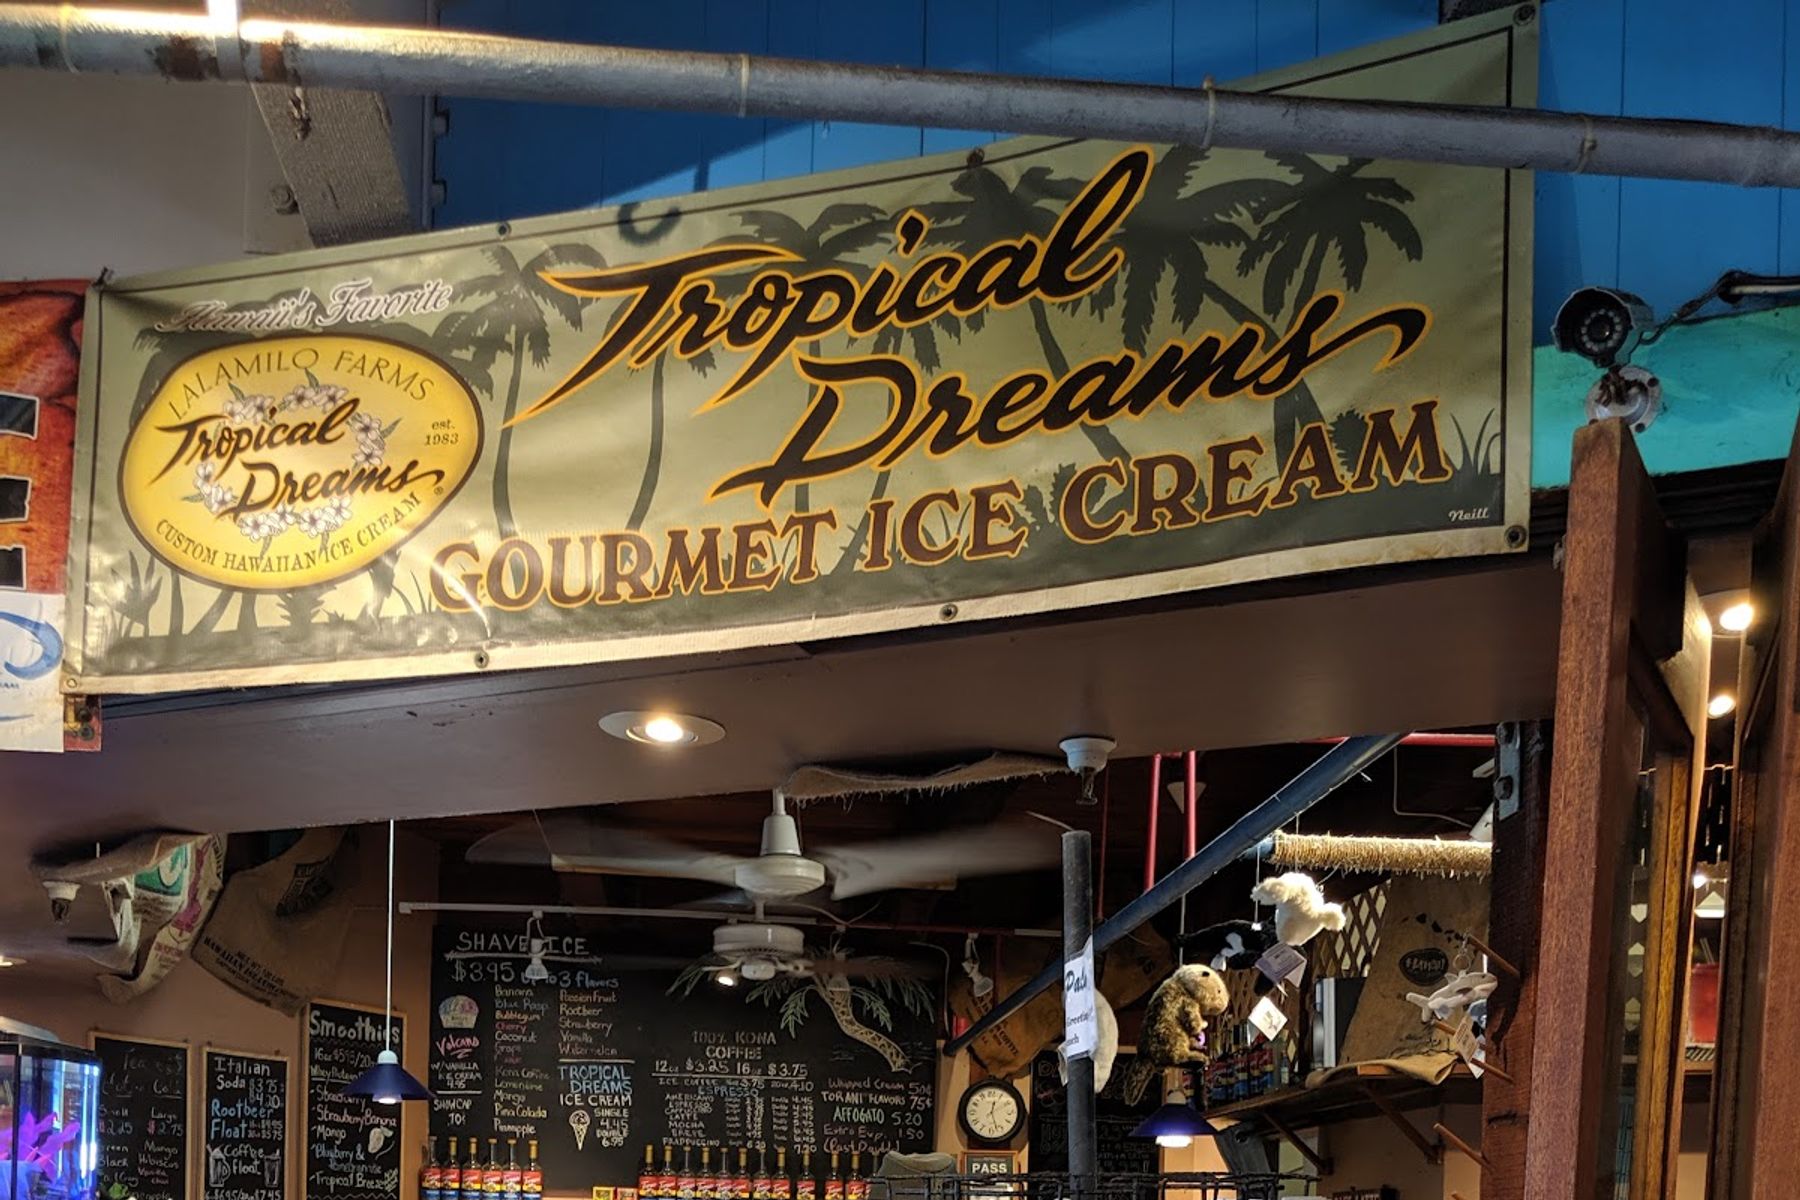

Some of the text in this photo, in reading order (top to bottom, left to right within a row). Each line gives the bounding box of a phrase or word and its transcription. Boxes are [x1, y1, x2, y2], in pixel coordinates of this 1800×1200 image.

[498, 143, 1155, 431] Tropical
[315, 277, 453, 326] Favorite
[167, 347, 434, 420] LALAMILO FARMS
[703, 290, 1432, 513] Dreams
[148, 398, 361, 485] Tropical
[424, 432, 460, 446] 1983
[215, 459, 445, 523] Dreams
[428, 400, 1451, 615] GOURMET ICE CREAM
[155, 492, 423, 574] CUSTOM HAWAIIAN ICE CREAM
[456, 931, 590, 955] SHAVE ICE
[452, 959, 515, 982] $3.95
[735, 1031, 777, 1045] KONA
[705, 1046, 762, 1060] COFFEE
[216, 1074, 246, 1090] Soda
[557, 1065, 631, 1080] TROPICAL
[570, 1080, 633, 1096] DREAMS
[698, 1086, 759, 1098] ESPRESSO
[560, 1093, 632, 1107] ICE CREAM
[821, 1091, 863, 1105] TORANI
[594, 1108, 629, 1118] SINGLE
[833, 1105, 885, 1124] AFFOGATO
[210, 1118, 248, 1140] Float
[668, 1121, 705, 1129] MOCHA
[317, 1125, 346, 1145] Mango
[972, 1162, 1008, 1174] PASS
